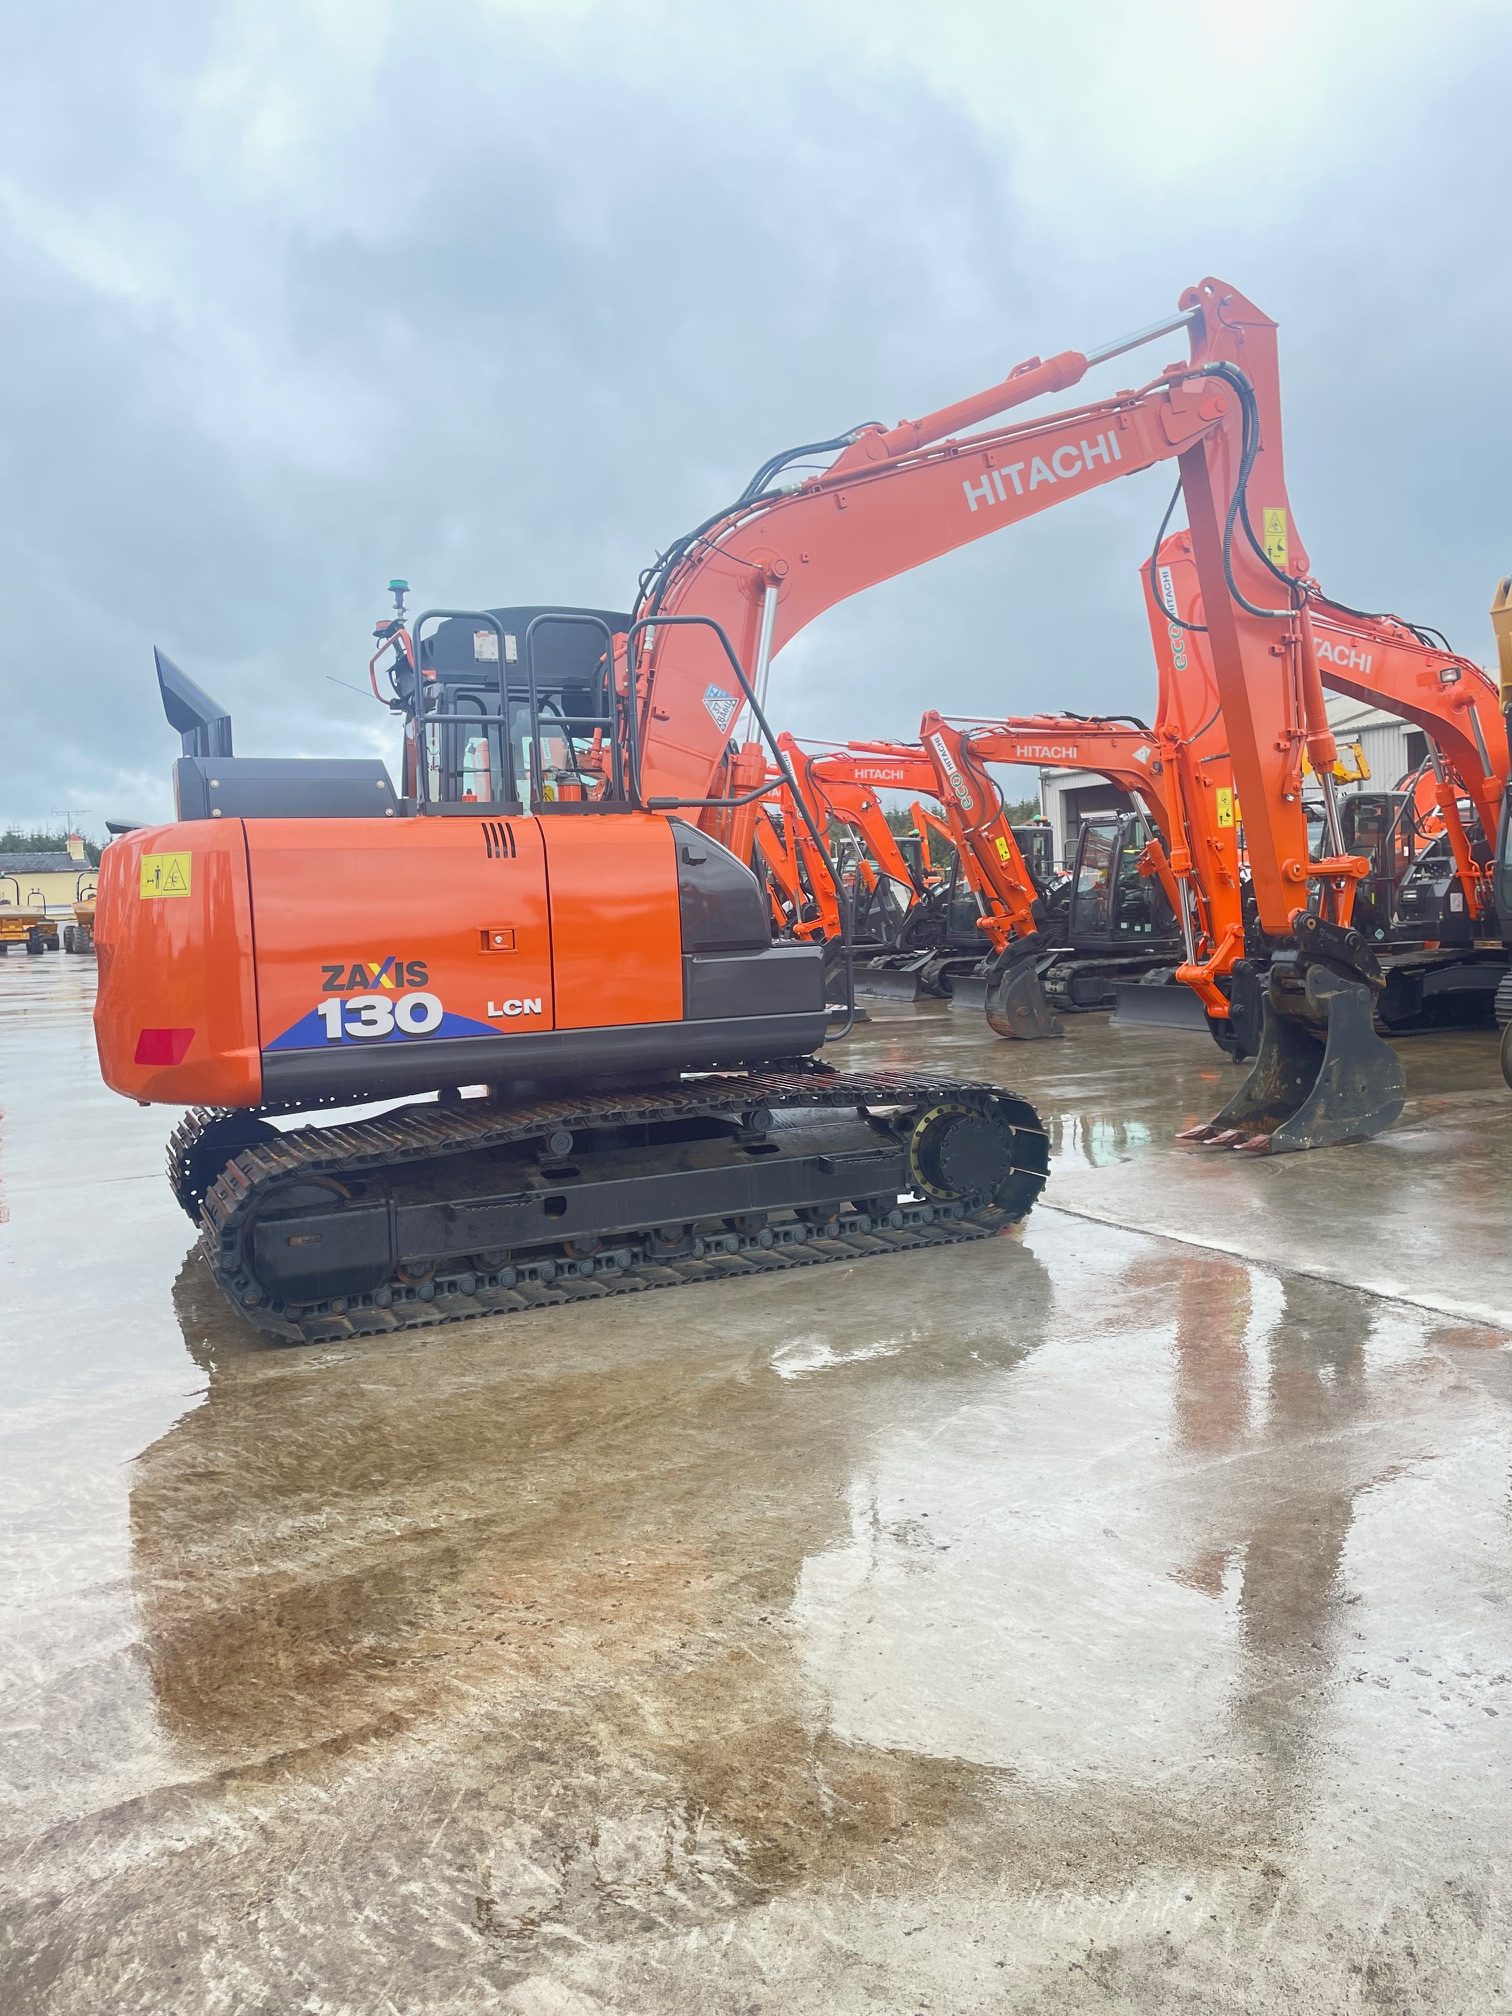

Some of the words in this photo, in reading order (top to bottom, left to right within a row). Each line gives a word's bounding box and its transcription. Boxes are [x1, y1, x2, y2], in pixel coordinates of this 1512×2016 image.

[962, 431, 1121, 512] HITACHI
[1162, 571, 1175, 615] HITACHI
[1168, 622, 1187, 670] eco
[1312, 637, 1372, 673] ACHI
[934, 737, 954, 771] HITACHI
[1016, 745, 1078, 759] HITACHI
[854, 768, 904, 780] HITACHI
[951, 772, 973, 810] eco
[322, 956, 430, 991] ZAXIS
[317, 992, 443, 1042] 130
[487, 998, 542, 1017] LCN
